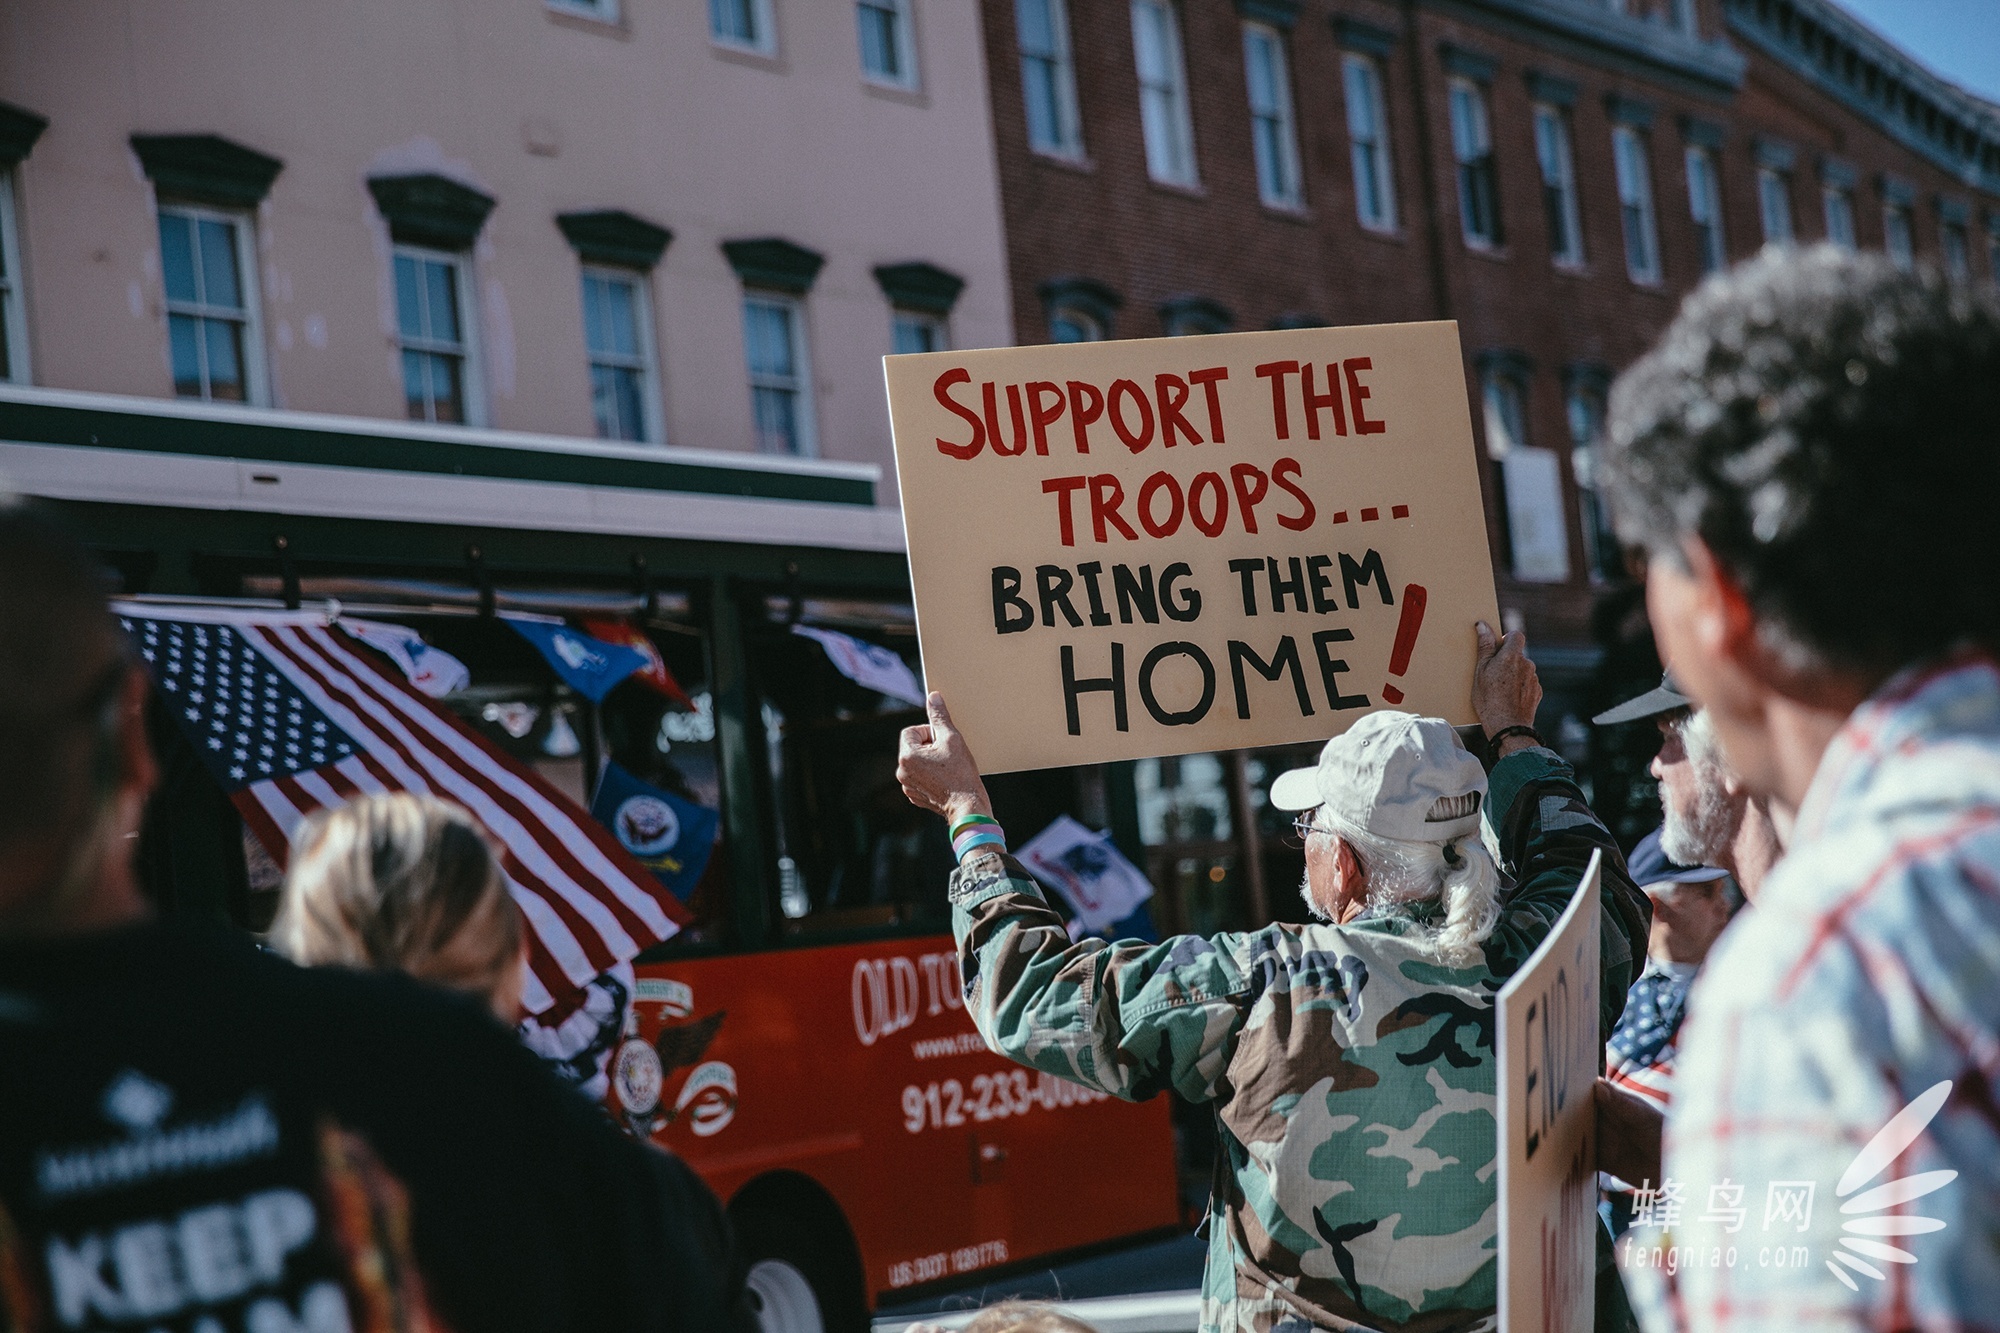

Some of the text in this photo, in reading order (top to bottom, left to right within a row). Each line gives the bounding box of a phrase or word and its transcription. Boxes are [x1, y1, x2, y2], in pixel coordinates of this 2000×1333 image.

[934, 358, 1384, 460] SUPPORT THE
[992, 549, 1394, 634] BRING THEM
[1061, 584, 1426, 735] HOME!
[853, 953, 963, 1046] OLD TO
[1525, 966, 1569, 1162] END
[47, 1187, 317, 1328] KEEP
